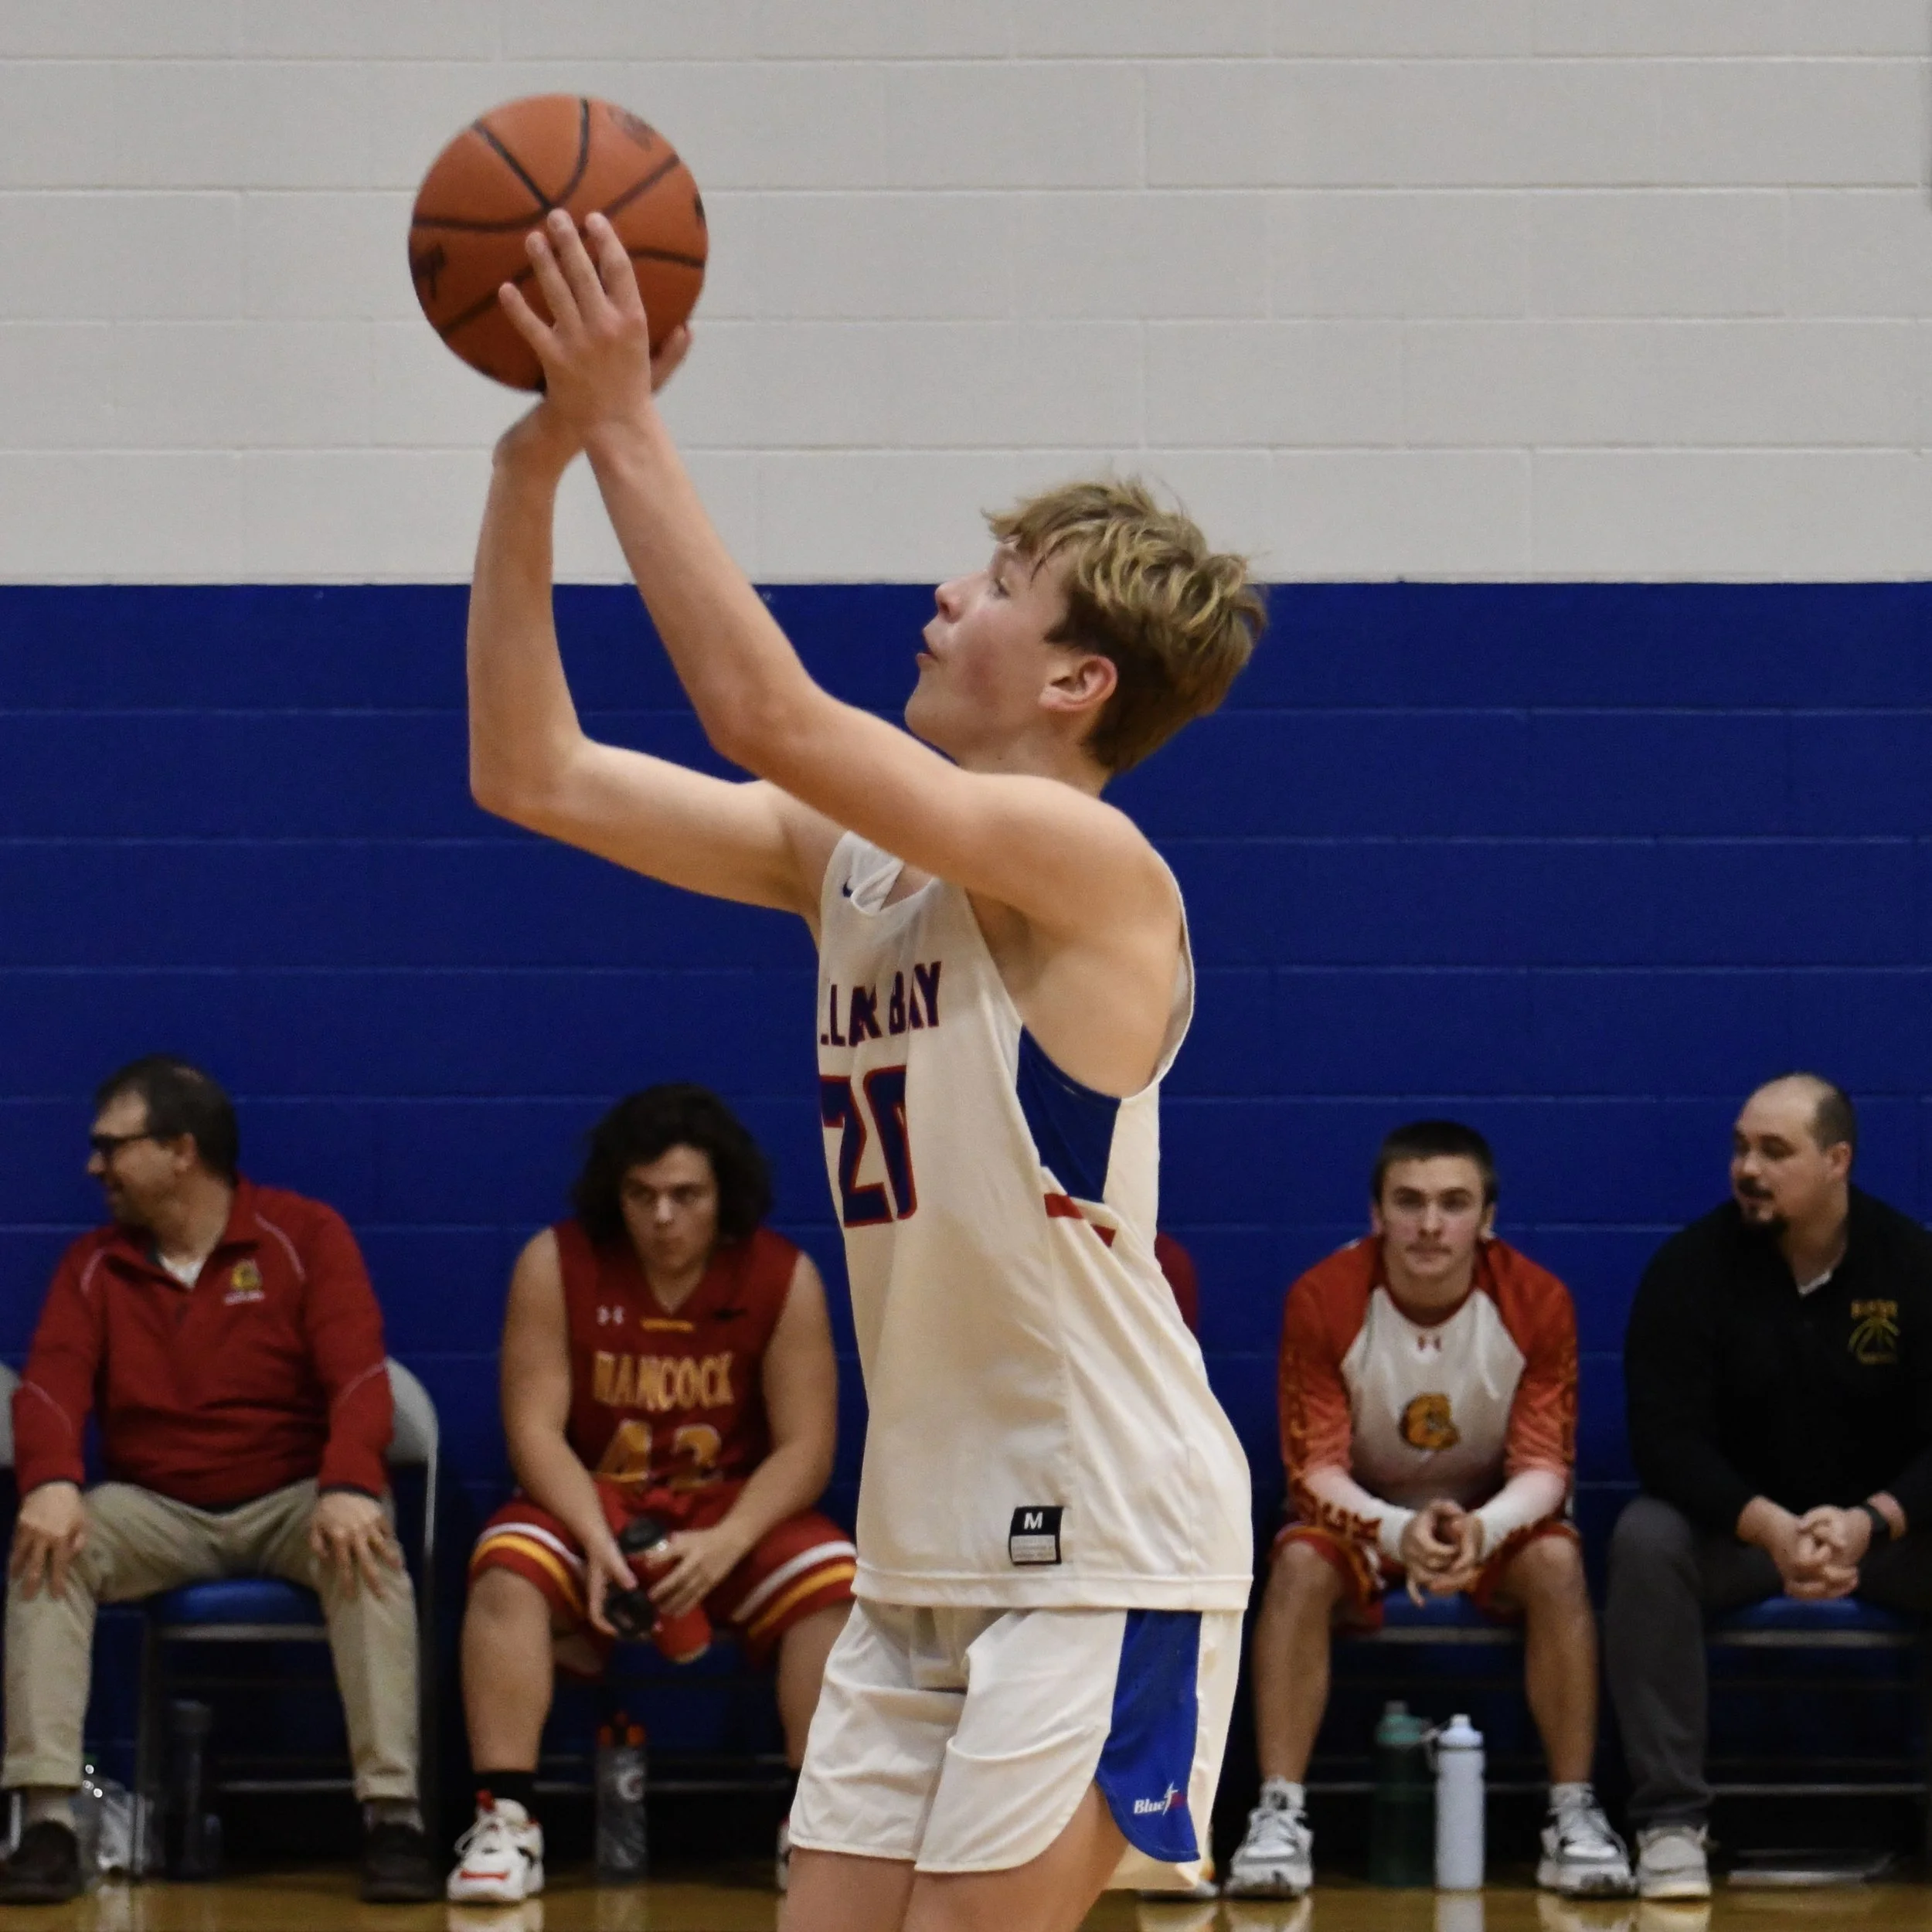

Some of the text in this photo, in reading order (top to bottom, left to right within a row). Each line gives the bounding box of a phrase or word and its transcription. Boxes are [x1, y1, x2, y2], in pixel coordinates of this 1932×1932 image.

[819, 1065, 918, 1228] 20
[1023, 1511, 1043, 1530] M
[1134, 1798, 1165, 1815] Blue
